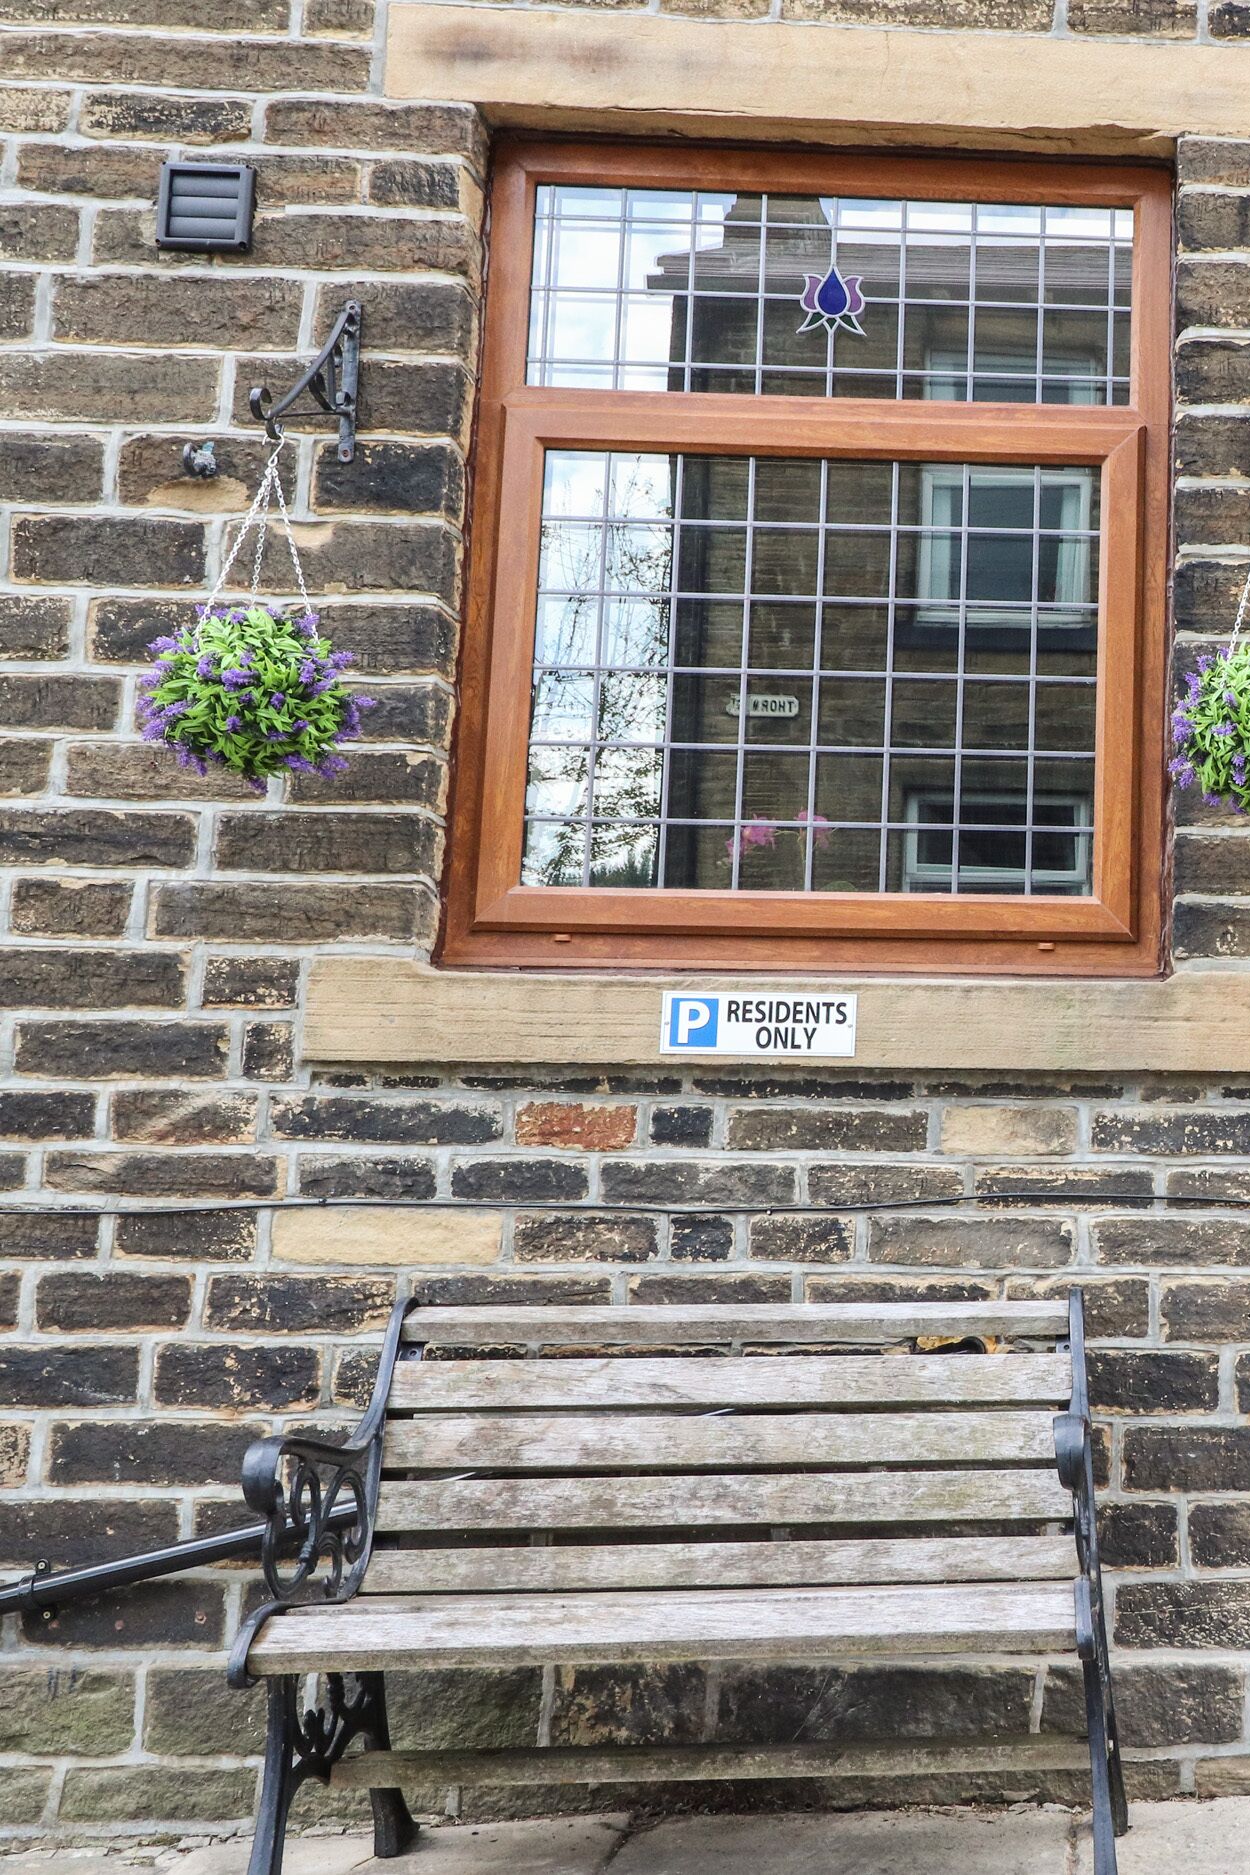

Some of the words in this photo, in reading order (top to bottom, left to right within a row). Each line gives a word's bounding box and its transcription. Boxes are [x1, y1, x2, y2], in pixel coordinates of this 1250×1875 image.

[678, 1001, 711, 1044] P
[727, 1000, 847, 1024] RESIDENTS
[755, 1026, 817, 1050] ONLY
